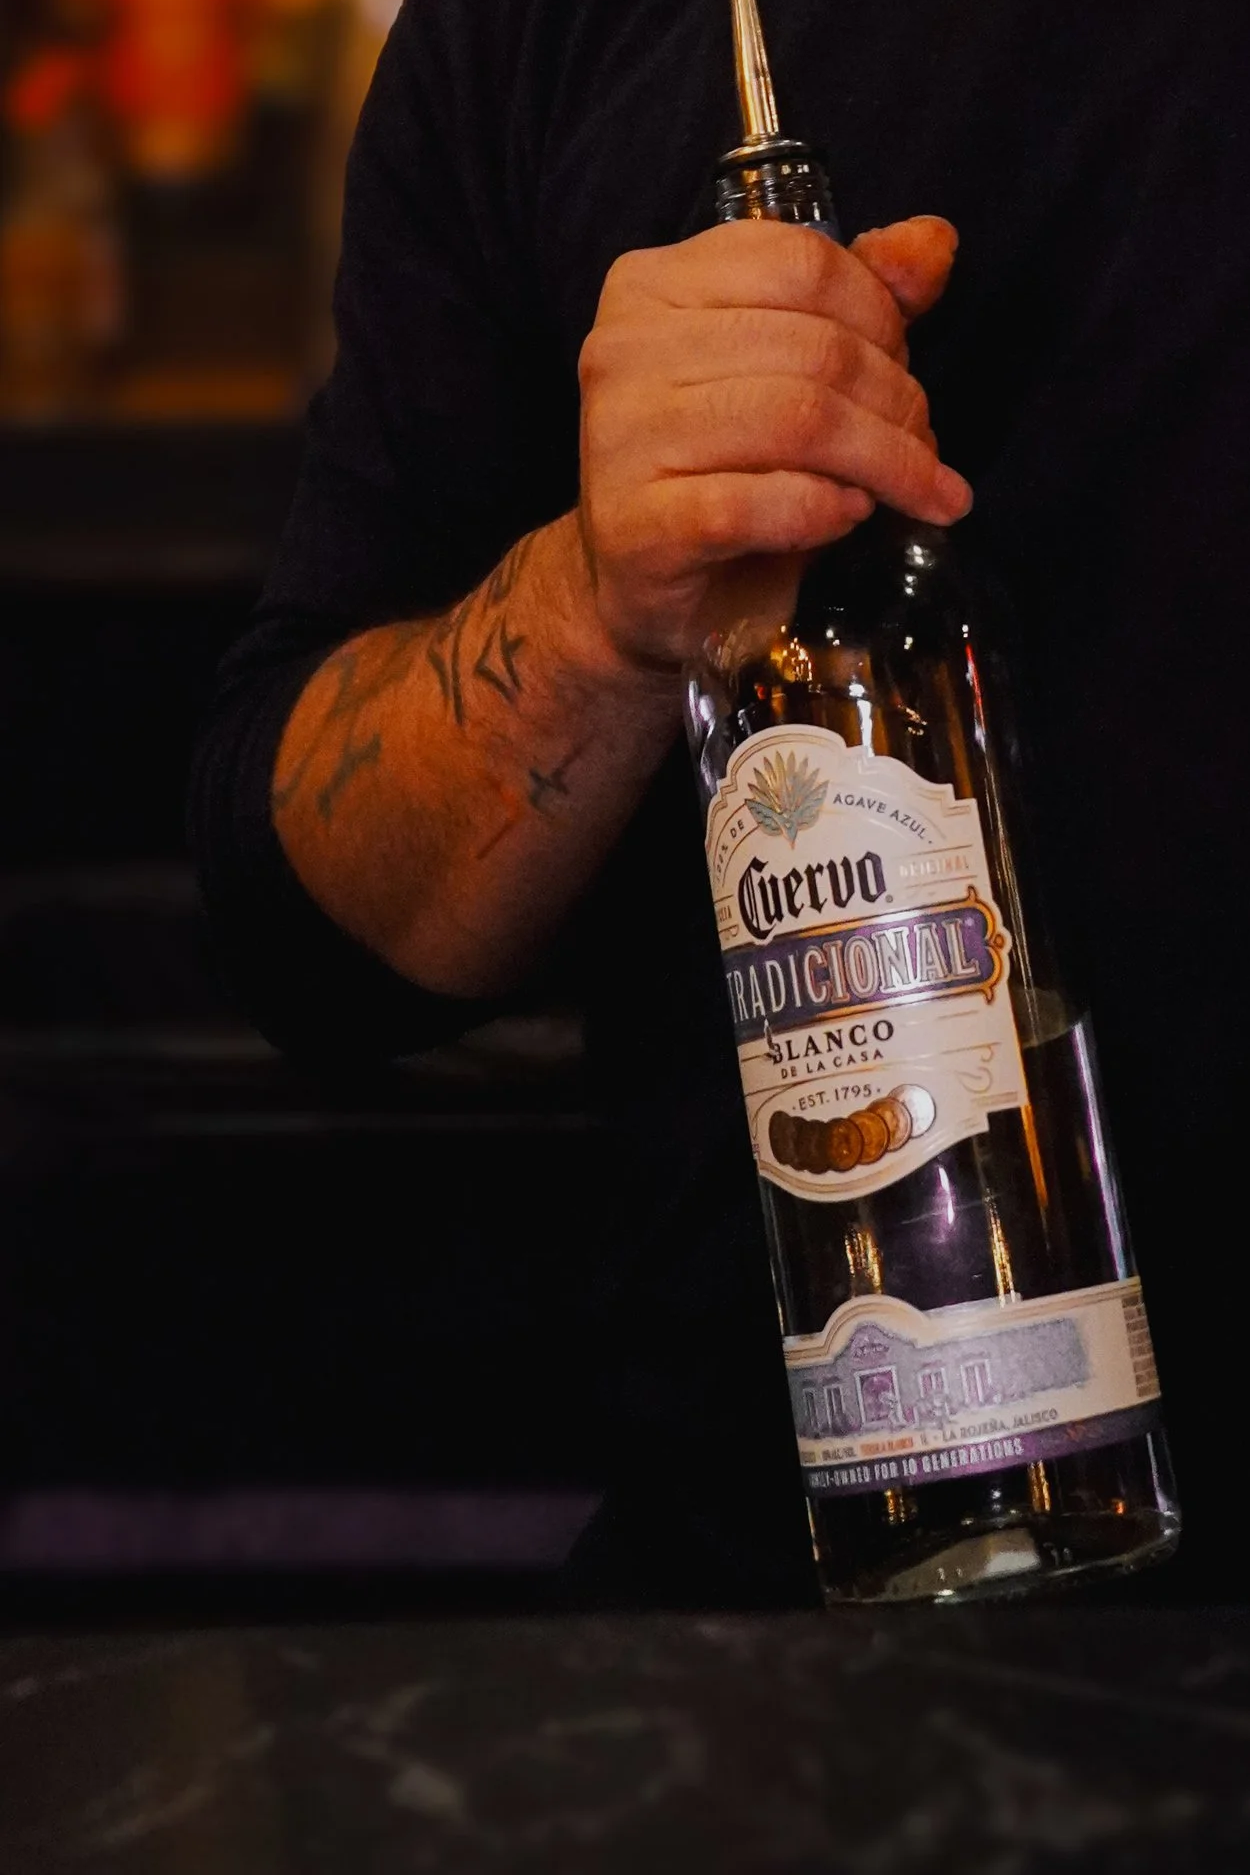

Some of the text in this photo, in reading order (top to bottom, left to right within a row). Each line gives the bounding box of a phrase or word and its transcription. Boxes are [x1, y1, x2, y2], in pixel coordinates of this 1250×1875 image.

[833, 793, 887, 813] AGAVE
[738, 850, 887, 940] Cuervo
[726, 916, 981, 1024] TRADICIONAL
[770, 1019, 894, 1065] BLANCO
[781, 1049, 884, 1079] DE LA CASA
[834, 1084, 873, 1102] 1795
[942, 1427, 957, 1442] LA
[1013, 1407, 1059, 1428] JALISCO
[874, 1461, 899, 1480] FOR
[921, 1436, 1024, 1473] GENERATIONS
